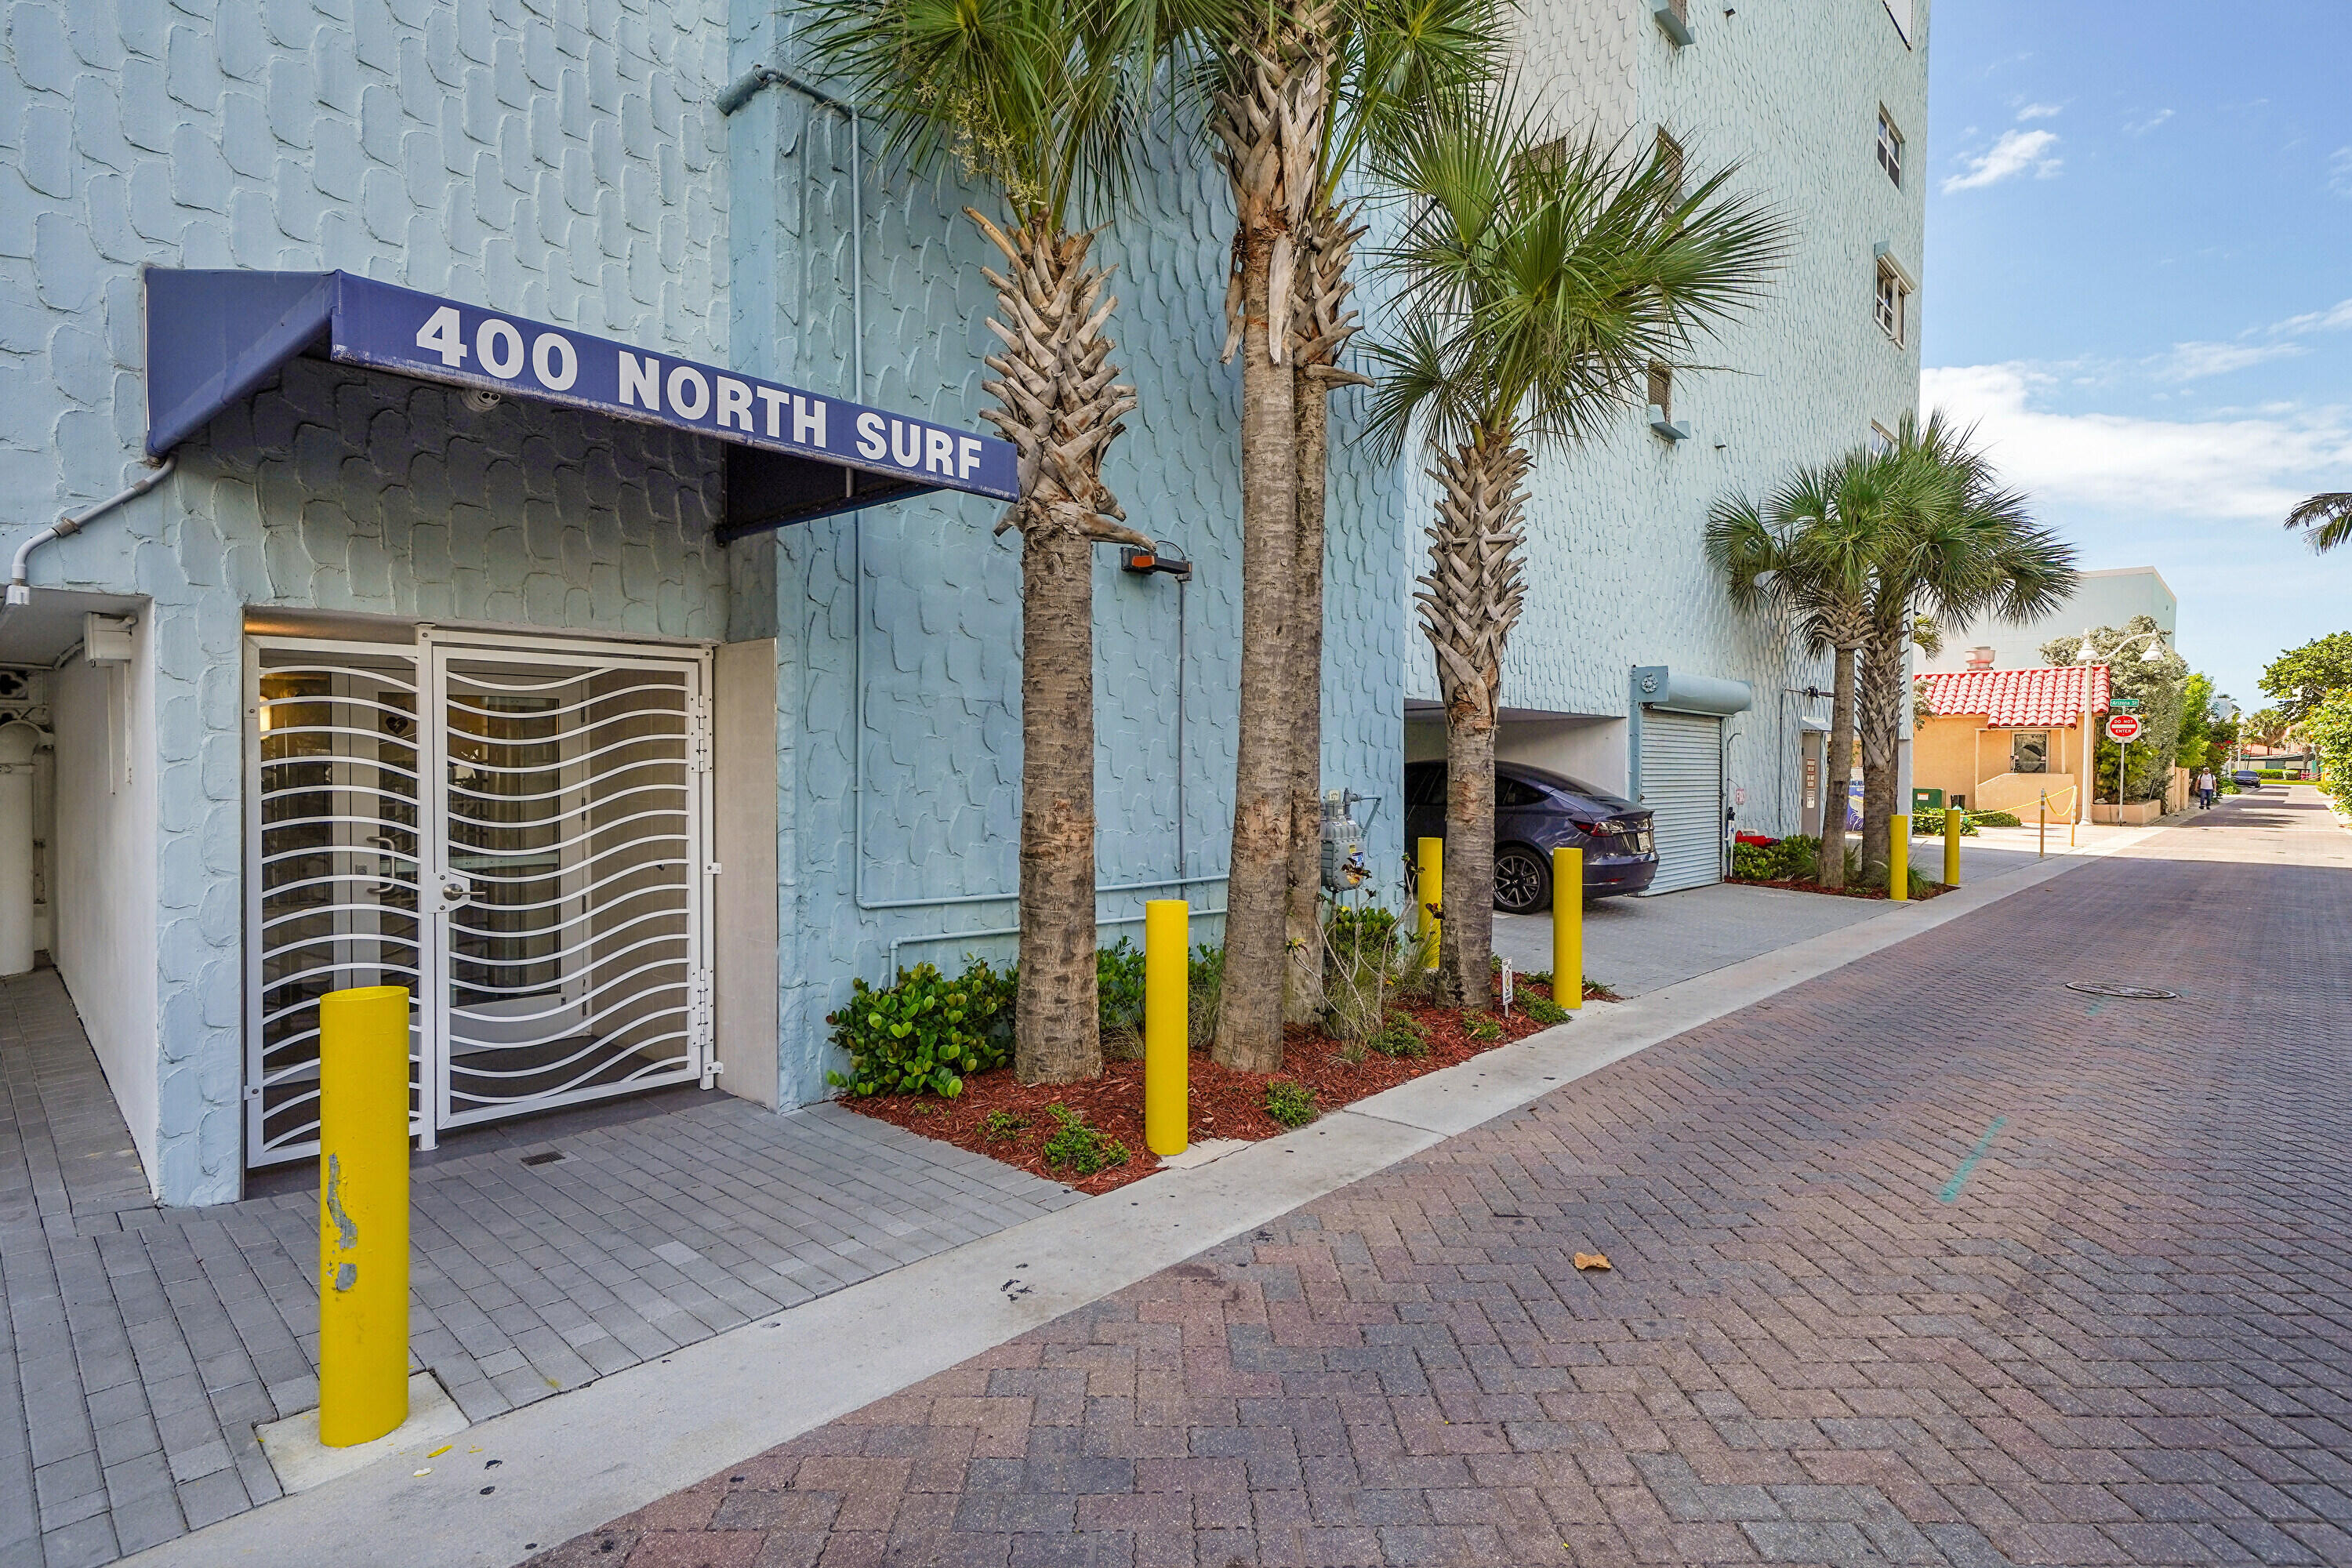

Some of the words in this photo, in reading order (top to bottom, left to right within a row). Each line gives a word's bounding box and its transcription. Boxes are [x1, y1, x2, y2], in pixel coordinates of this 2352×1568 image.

[416, 306, 578, 391] 400
[619, 350, 826, 448] NORTH
[856, 412, 982, 480] SURF
